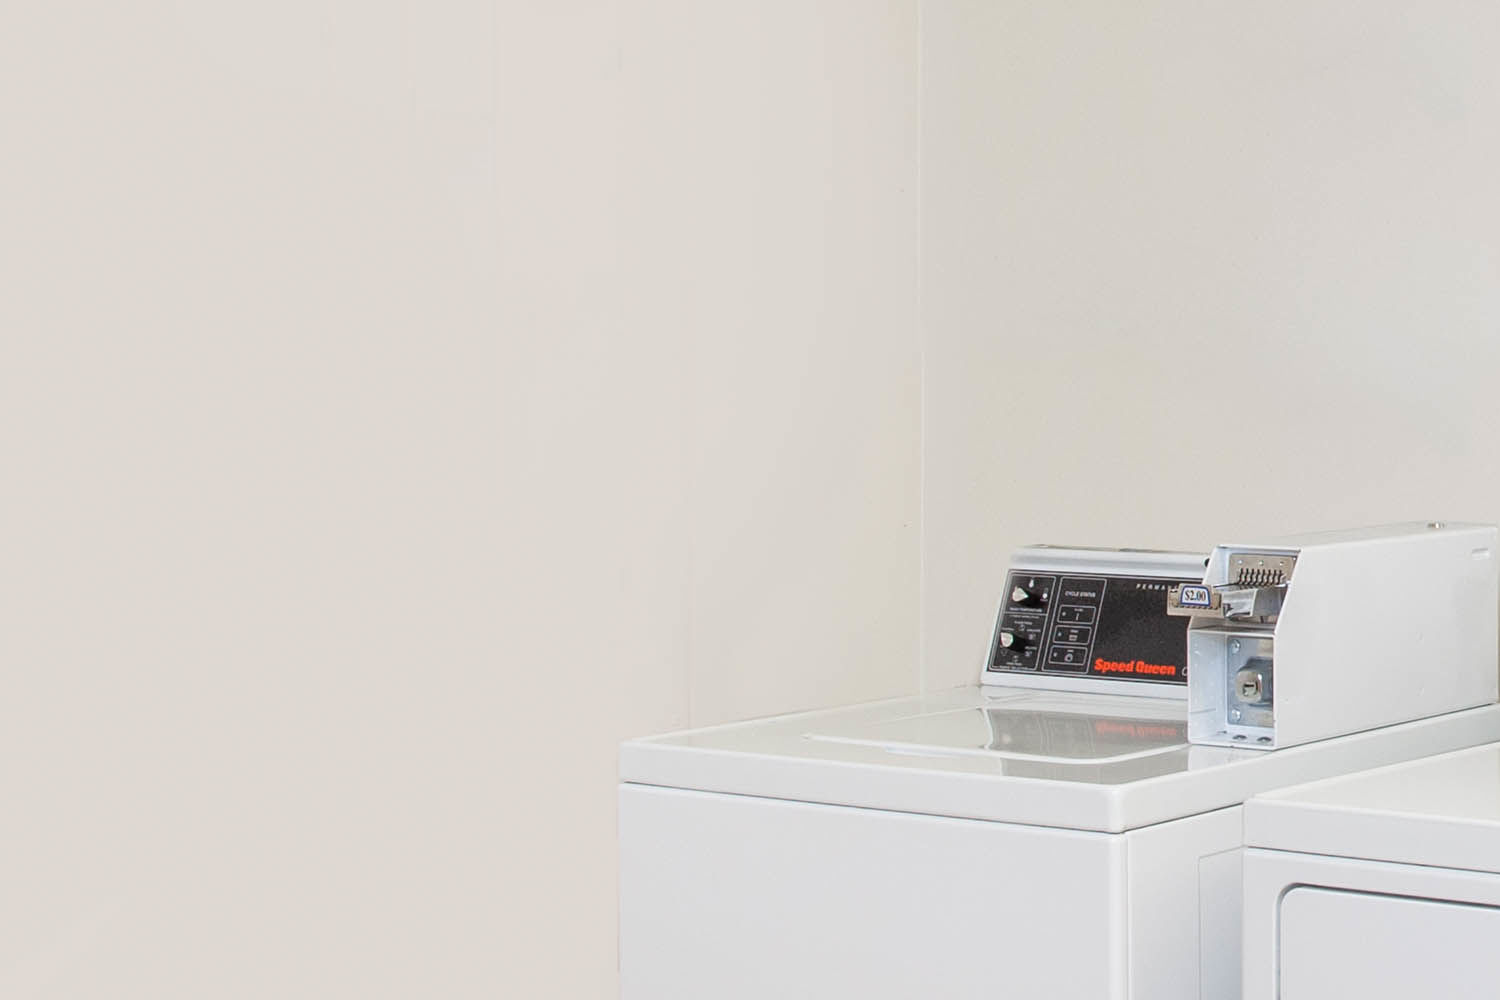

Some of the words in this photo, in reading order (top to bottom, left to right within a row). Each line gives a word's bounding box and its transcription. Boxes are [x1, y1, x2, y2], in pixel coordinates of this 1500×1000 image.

[1184, 590, 1206, 602] $2.00
[1094, 658, 1135, 673] Speed
[1136, 661, 1176, 676] Queen
